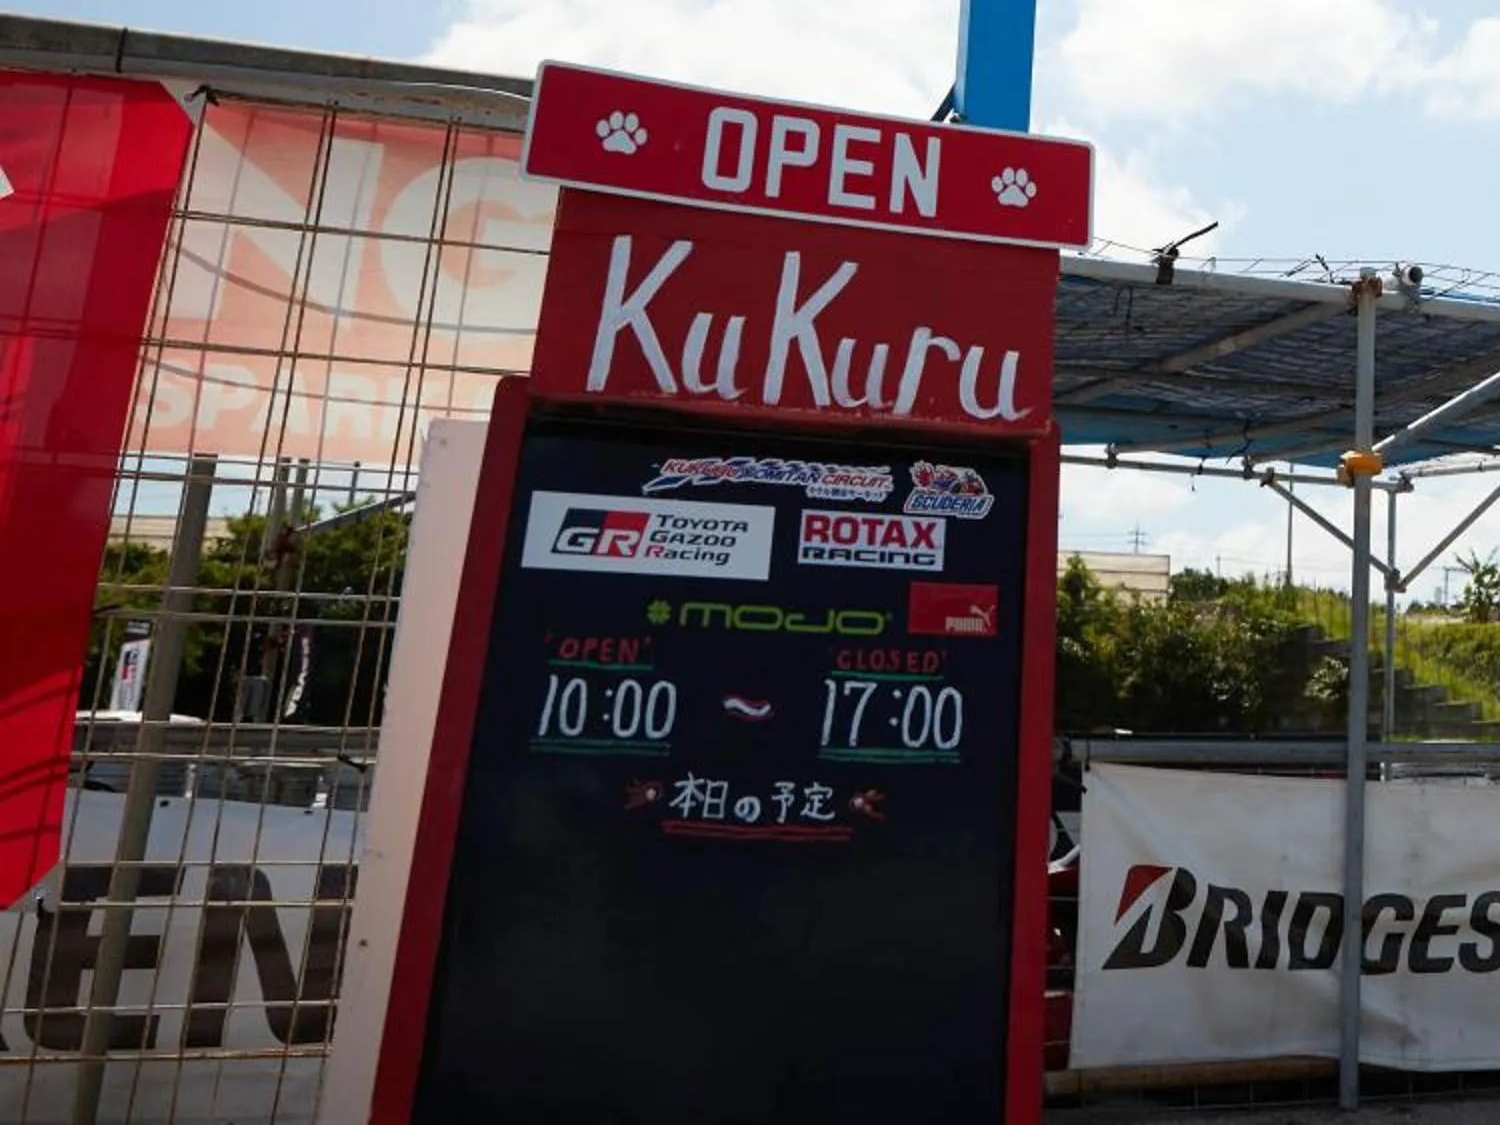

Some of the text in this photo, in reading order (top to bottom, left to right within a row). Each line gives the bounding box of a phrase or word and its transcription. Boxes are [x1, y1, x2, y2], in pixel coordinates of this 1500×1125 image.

[701, 106, 941, 218] OPEN
[822, 474, 889, 488] CIRCUIT
[911, 493, 988, 514] SCUDERIA
[656, 513, 748, 533] TOYOTA
[804, 514, 937, 549] ROTAX
[555, 527, 640, 557] GR
[650, 530, 736, 548] GAZOO
[644, 545, 731, 566] Racing
[802, 546, 936, 565] RACING
[539, 675, 677, 739] 10:00
[821, 679, 964, 749] 17:00
[668, 771, 837, 823] 本日の予定
